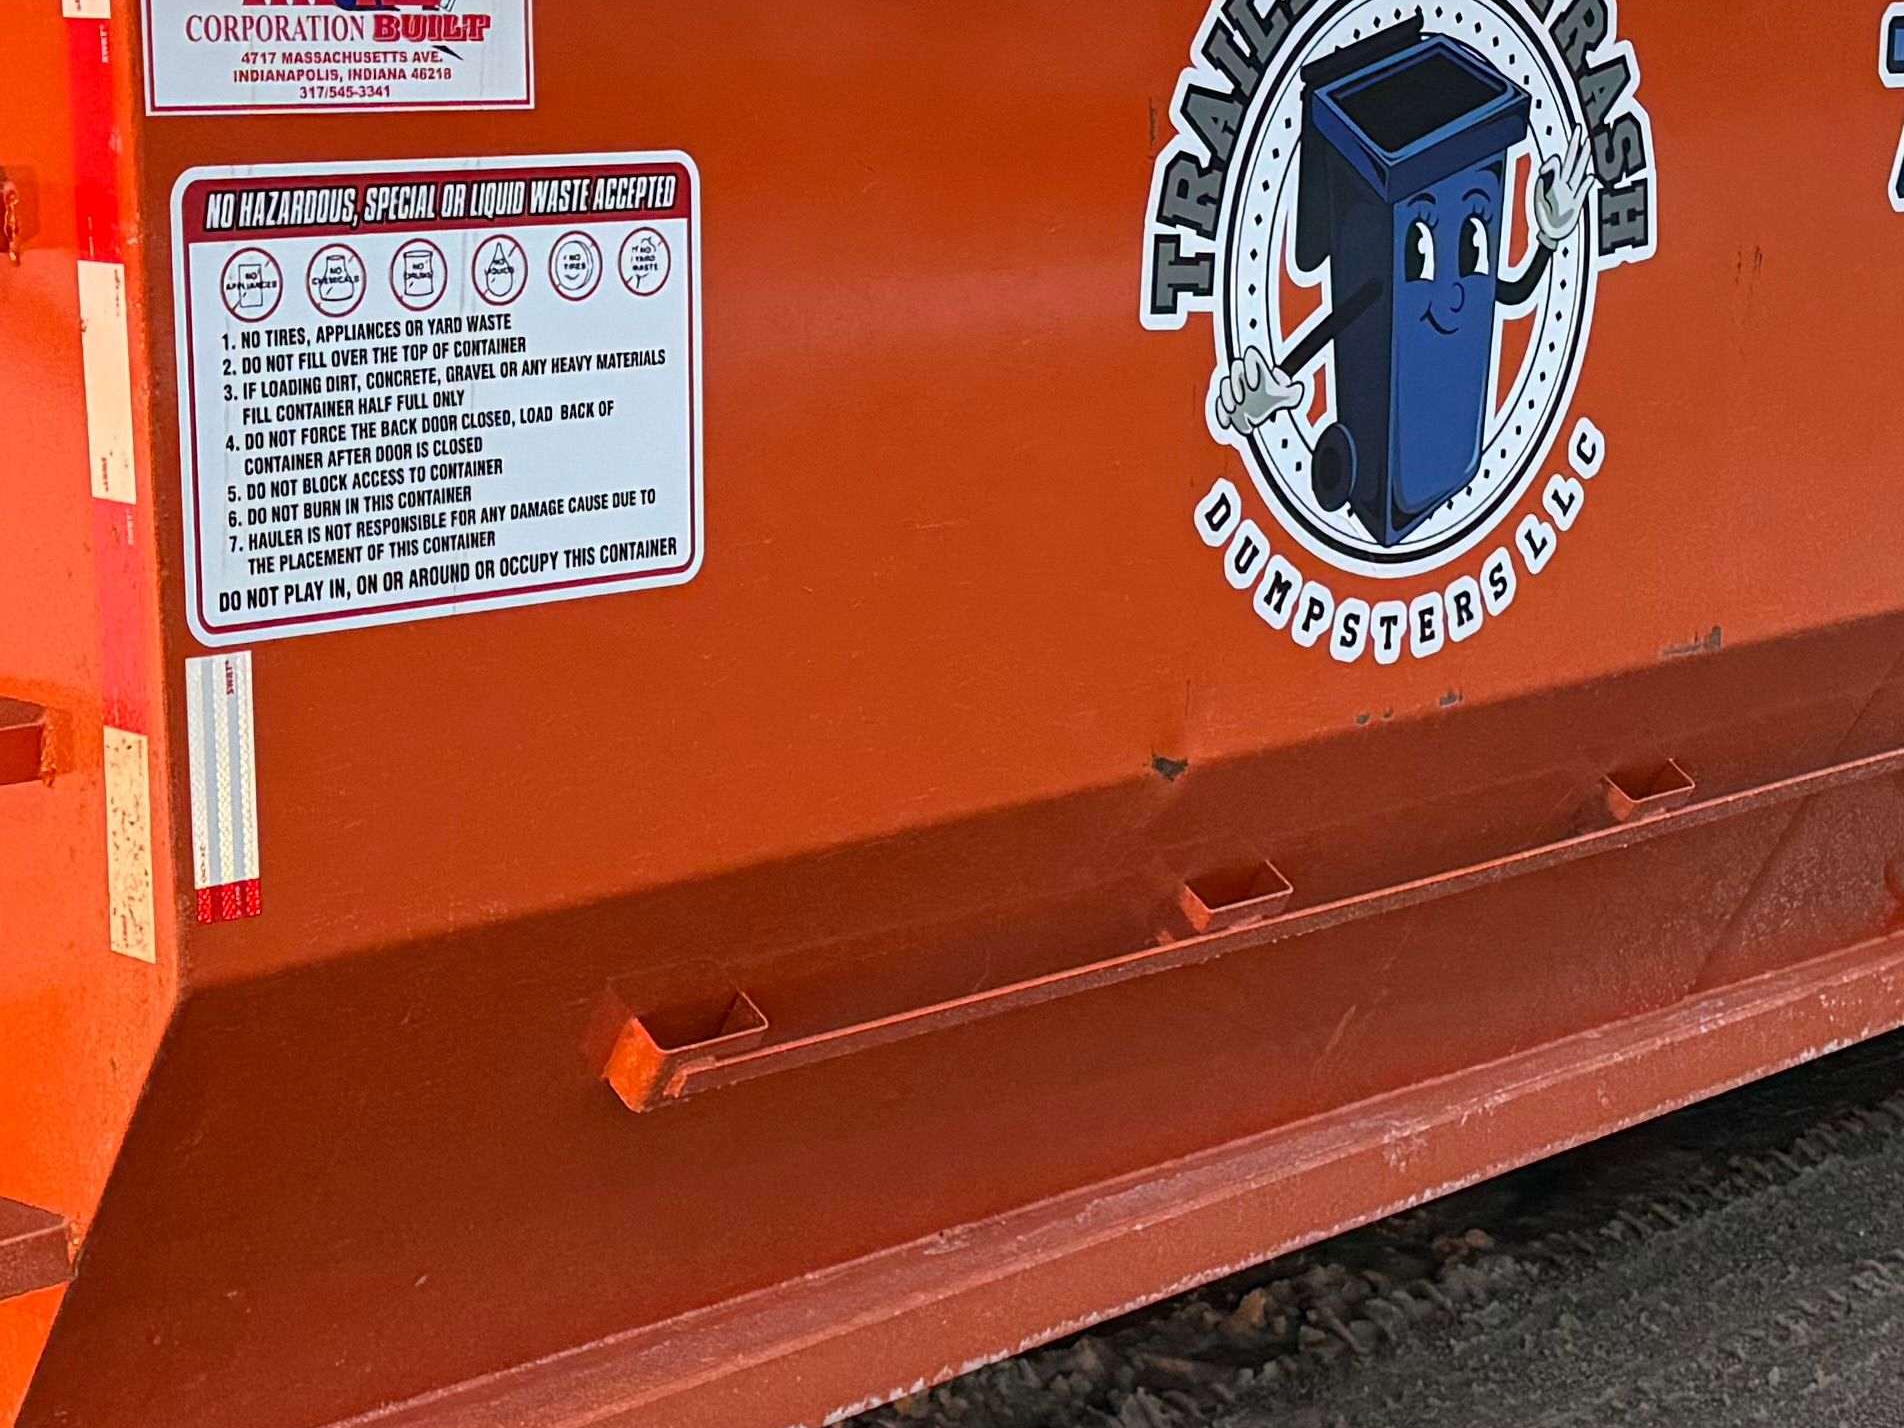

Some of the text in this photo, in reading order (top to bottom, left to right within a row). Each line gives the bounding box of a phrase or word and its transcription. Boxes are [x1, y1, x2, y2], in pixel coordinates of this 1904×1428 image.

[186, 13, 492, 42] CORPORATION BUILT
[234, 68, 451, 81] INDIANAPOLIS, INDIANA 46218
[242, 51, 445, 63] 4717 MASSACHUSETTS AVE.
[300, 85, 389, 98] 317/545-3341
[205, 175, 677, 229] NO HAZARDOUS, SPECIAL OR LIQUID WASTE ACCEPTED
[222, 313, 510, 350] 1. NO TIRES, APPLIANCES OR YARD WASTE
[223, 337, 525, 375] 2. DO NOT FILL OVER THE TOP OF CONTAINER
[224, 349, 665, 400] 3. IF LOADING DIRT, CONCRETE, GRAVEL OR ANY HEAVY MATERIALS
[226, 400, 613, 451] 4. DO NOT FORCE THE BACK DOOR CLOSED, LOAD BACK OF
[243, 390, 464, 424] FILL CONTAINER HALF FULL ONLY
[245, 436, 482, 475] CONTAINER AFTER DOOR IS CLOSED
[228, 458, 502, 501] 5. DO NOT BLOCK ACCESS TO CONTAINER
[229, 486, 471, 527] 6. DO NOT BURN IN THIS CONTAINER
[229, 488, 655, 551] 7. HAULER IS NOT RESPONSIBLE FOR ANY DAMAGE CAUSE DUE TO
[248, 531, 494, 574] THE PLACEMENT OF THIS CONTAINER
[1204, 431, 1597, 651] DUMPSTERS LLC
[219, 537, 676, 611] DO NOT PLAY IN, ON OR AROUND OR OCCUPY THIS CONTAINER
